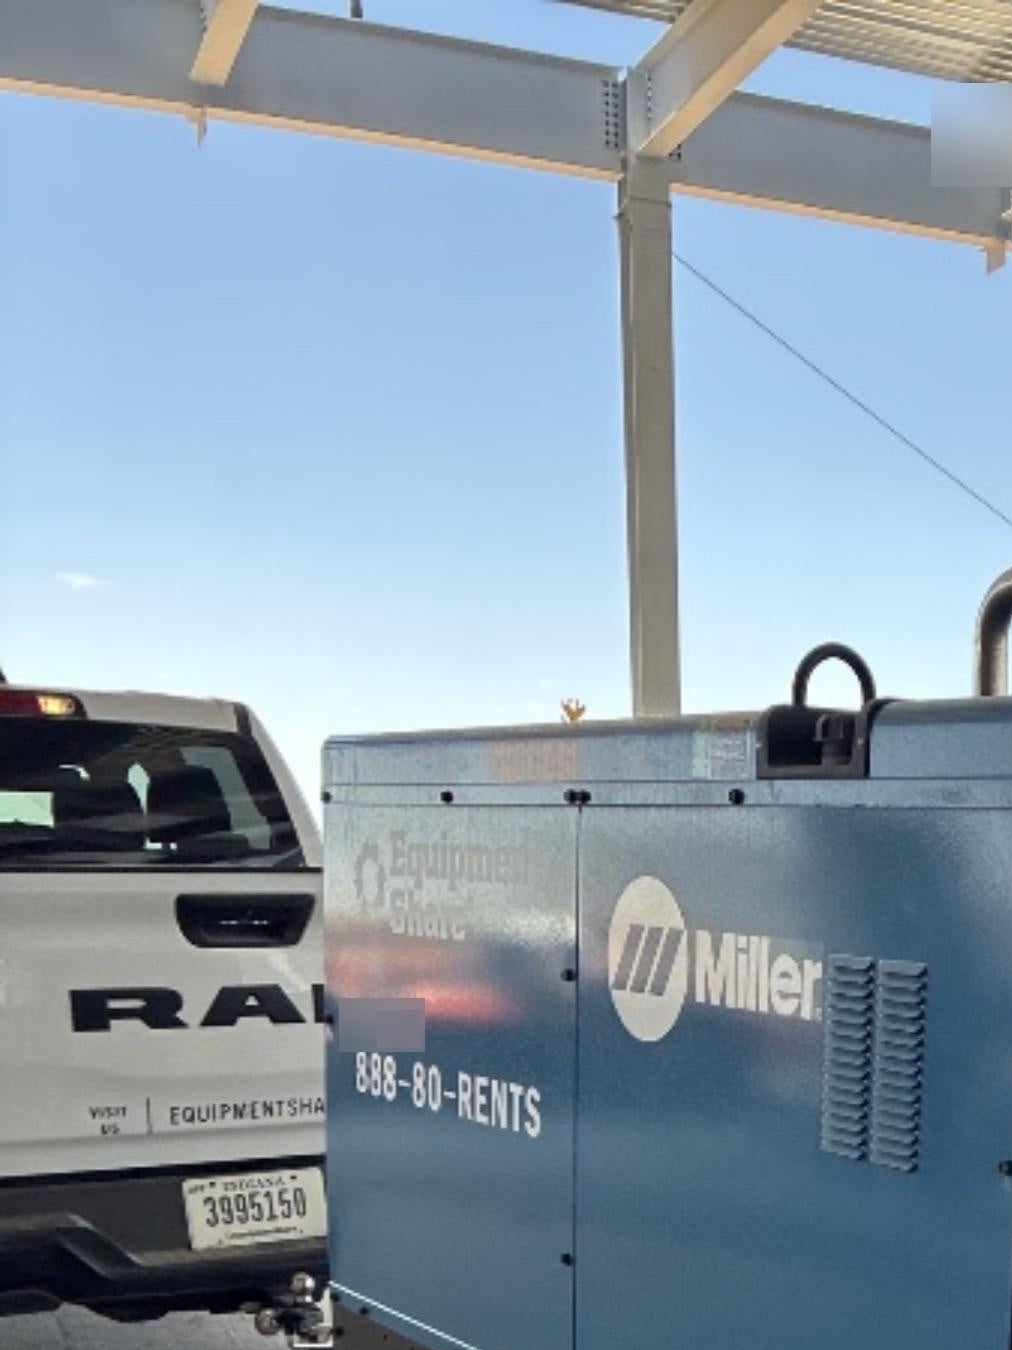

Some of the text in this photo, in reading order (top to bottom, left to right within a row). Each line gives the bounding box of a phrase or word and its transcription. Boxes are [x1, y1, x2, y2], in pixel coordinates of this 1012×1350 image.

[69, 984, 324, 1032] RA
[694, 929, 823, 1022] Miller
[355, 1051, 542, 1138] 888-80-RENTS
[203, 1187, 307, 1228] 3995150
